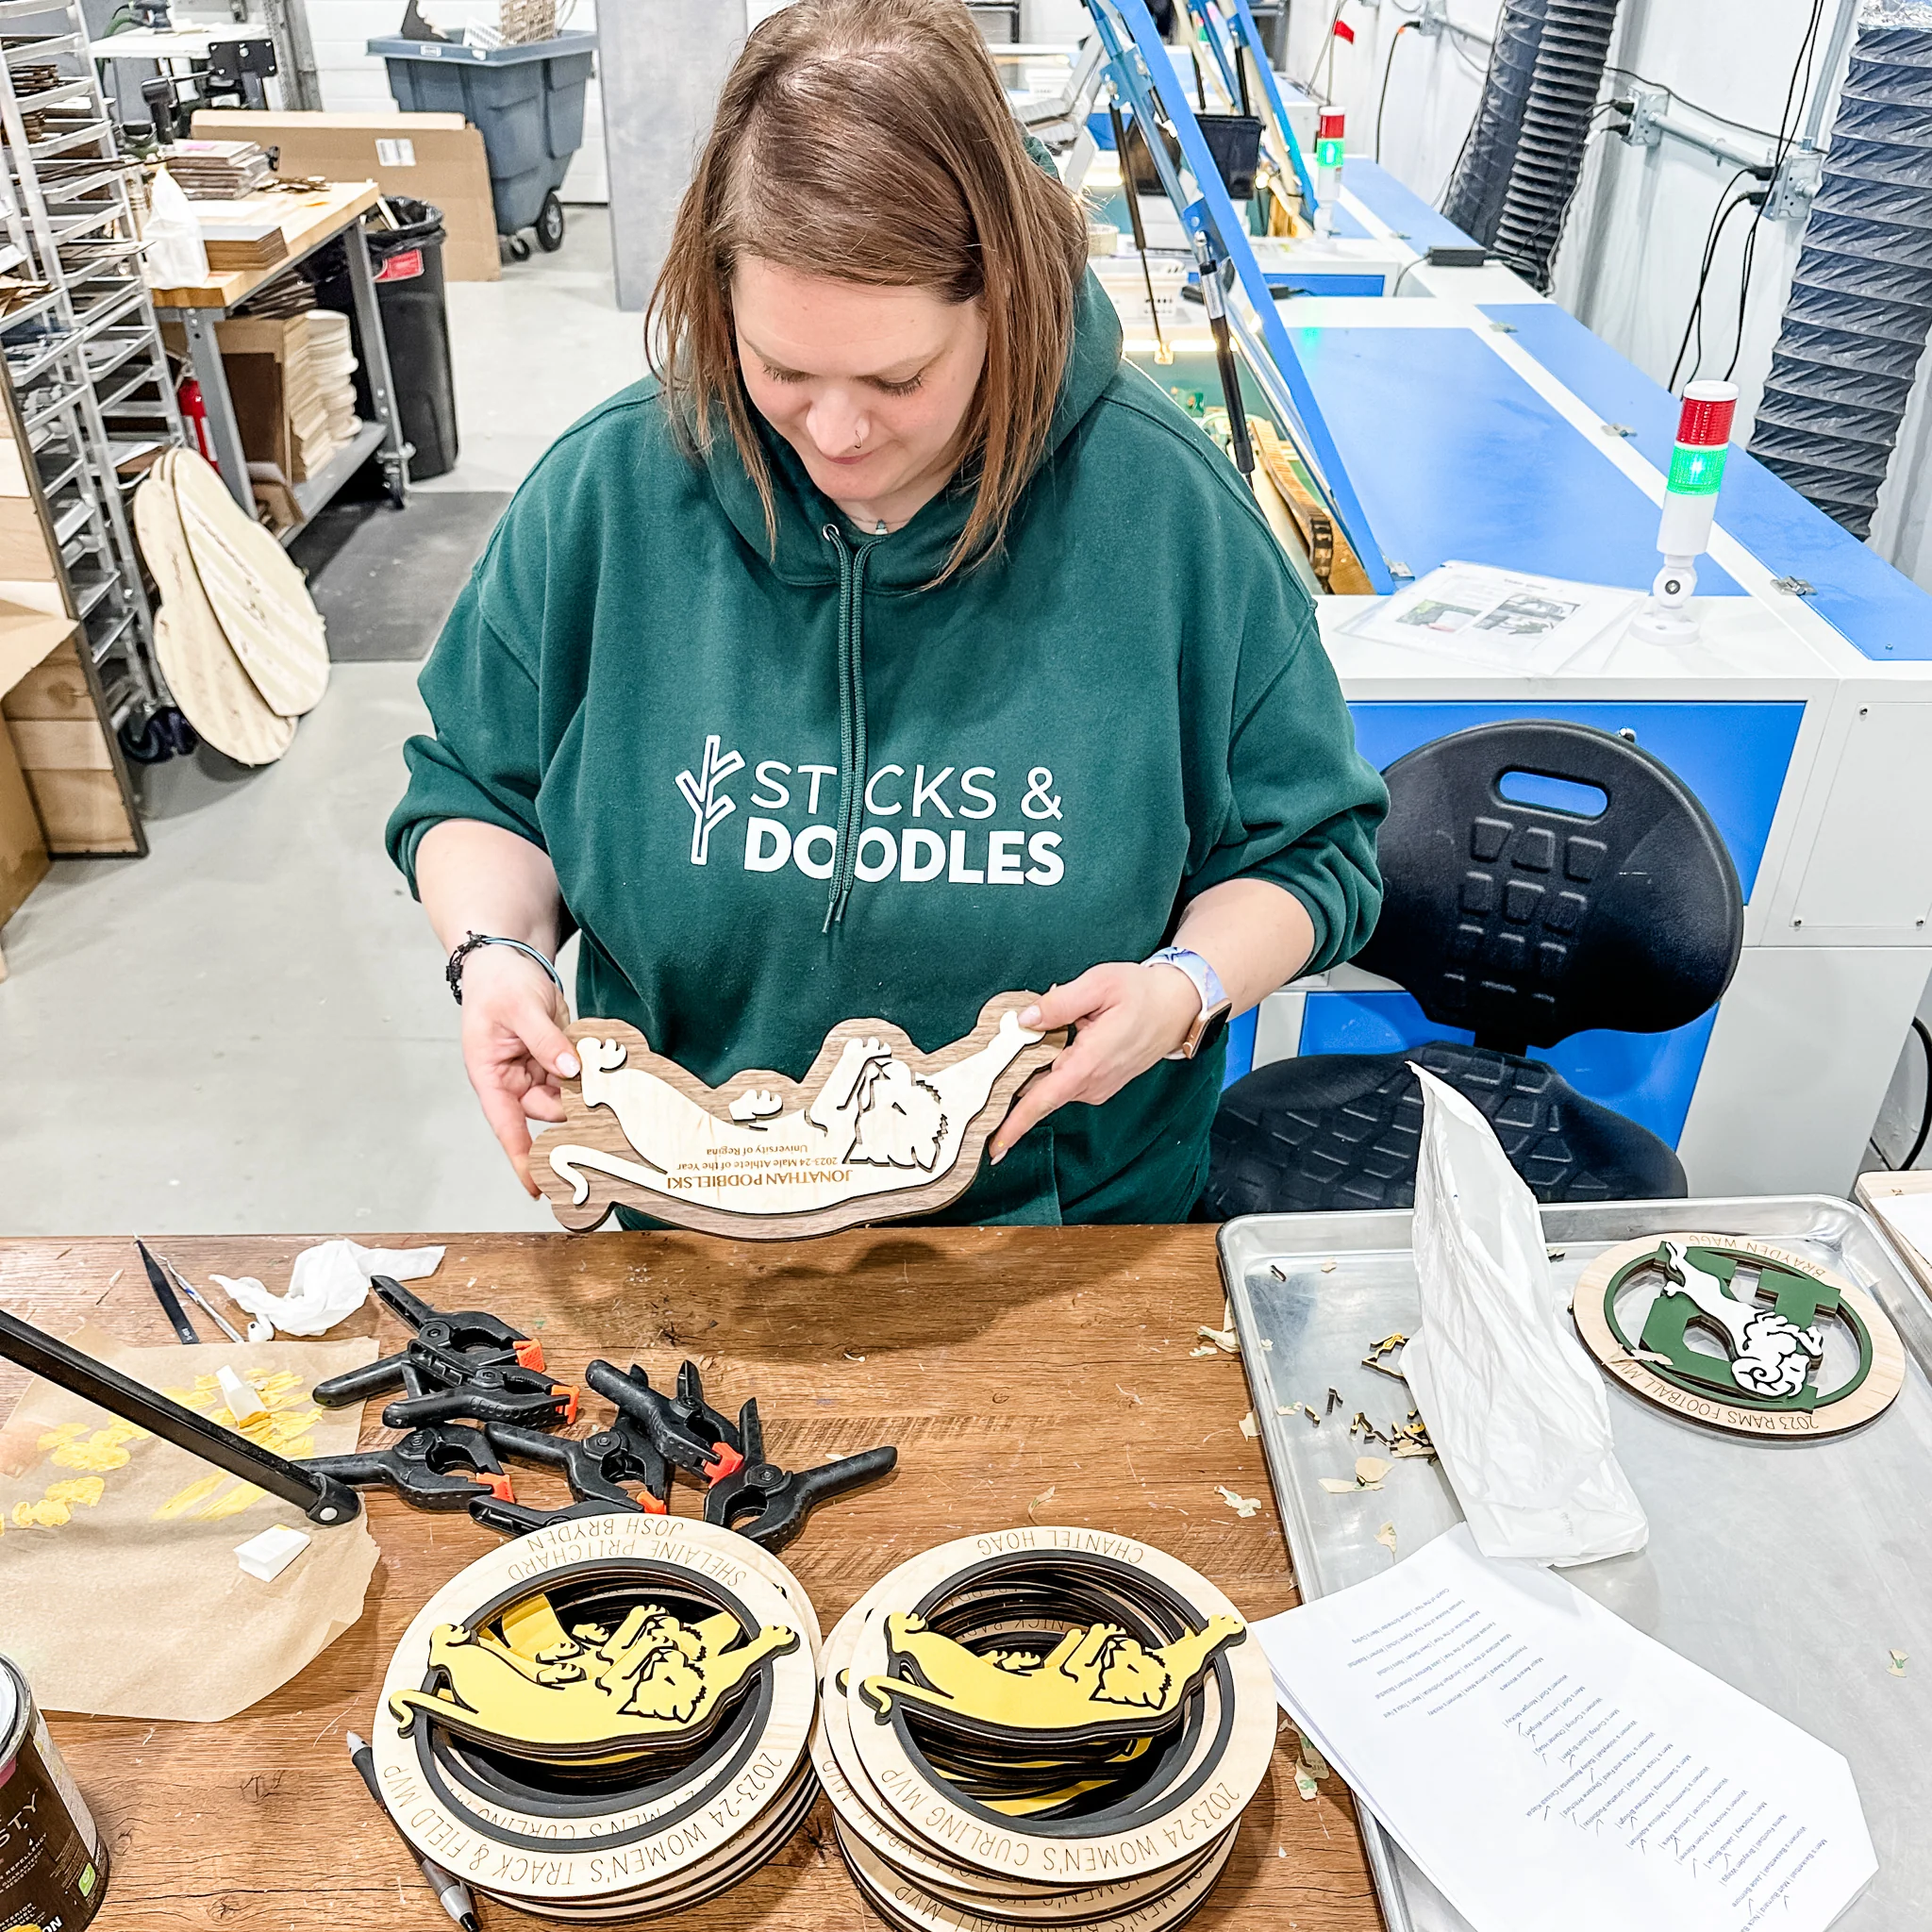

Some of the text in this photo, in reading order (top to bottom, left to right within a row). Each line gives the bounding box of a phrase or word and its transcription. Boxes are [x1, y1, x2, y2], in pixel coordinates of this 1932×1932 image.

[750, 760, 1064, 821] STCKS &
[743, 816, 1065, 886] DOODLES
[676, 1158, 838, 1171] 2023-24 Male Athlete of the Year
[707, 1144, 808, 1156] University of Regina
[667, 1169, 853, 1189] JONATHAN PODBIELSKI
[1690, 1235, 1825, 1278] BRAYDEN WAGG
[1616, 1361, 1819, 1430] 2023 RAMS FOOTBALL MV
[526, 1517, 684, 1553] JOSH BRYDEN
[976, 1530, 1143, 1564] CHANTEL HOAG
[508, 1540, 747, 1587] SHELAINE PRITCHARD
[383, 1765, 422, 1808] MVP
[708, 1753, 782, 1828] 2023-24
[881, 1769, 929, 1811] MVP
[410, 1808, 471, 1858] FIELD
[1163, 1782, 1241, 1848] 2023-24
[1707, 1801, 1767, 1864] Men's Hockey Jakob Brook
[6, 1832, 47, 1875] REPELLENCY
[469, 1843, 490, 1871] &
[591, 1823, 708, 1883] WOMEN'S
[925, 1807, 1029, 1866] CURLING
[1042, 1835, 1159, 1874] WOMEN'S
[1721, 1814, 1787, 1882] Rams Football Brayden Wagg
[1810, 1839, 1827, 1854] Men's
[5, 1859, 38, 1889] RESISTANT
[491, 1854, 575, 1886] TRACK
[1731, 1826, 1807, 1907] Women's Basketball Jade Belmore
[1776, 1880, 1790, 1892] Matt
[1790, 1853, 1814, 1878] Basketball
[894, 1886, 944, 1922] MVP
[1747, 1914, 1760, 1926] Nick
[1759, 1891, 1780, 1912] Barnard
